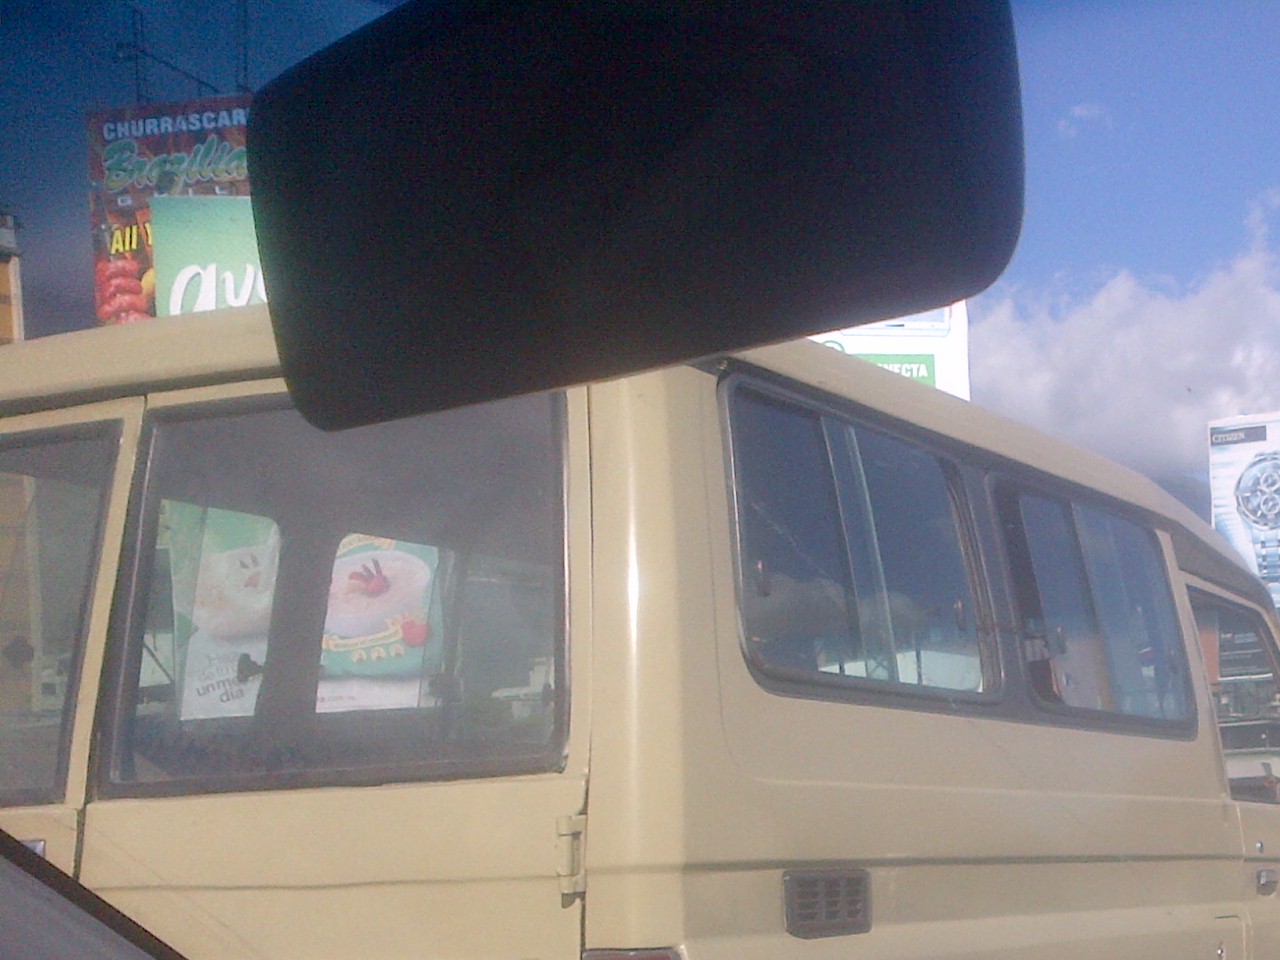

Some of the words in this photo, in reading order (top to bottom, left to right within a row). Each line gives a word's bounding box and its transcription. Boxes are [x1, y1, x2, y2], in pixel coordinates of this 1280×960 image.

[103, 108, 249, 141] CHURRASCAR
[111, 225, 137, 254] All
[877, 363, 929, 378] NECTA
